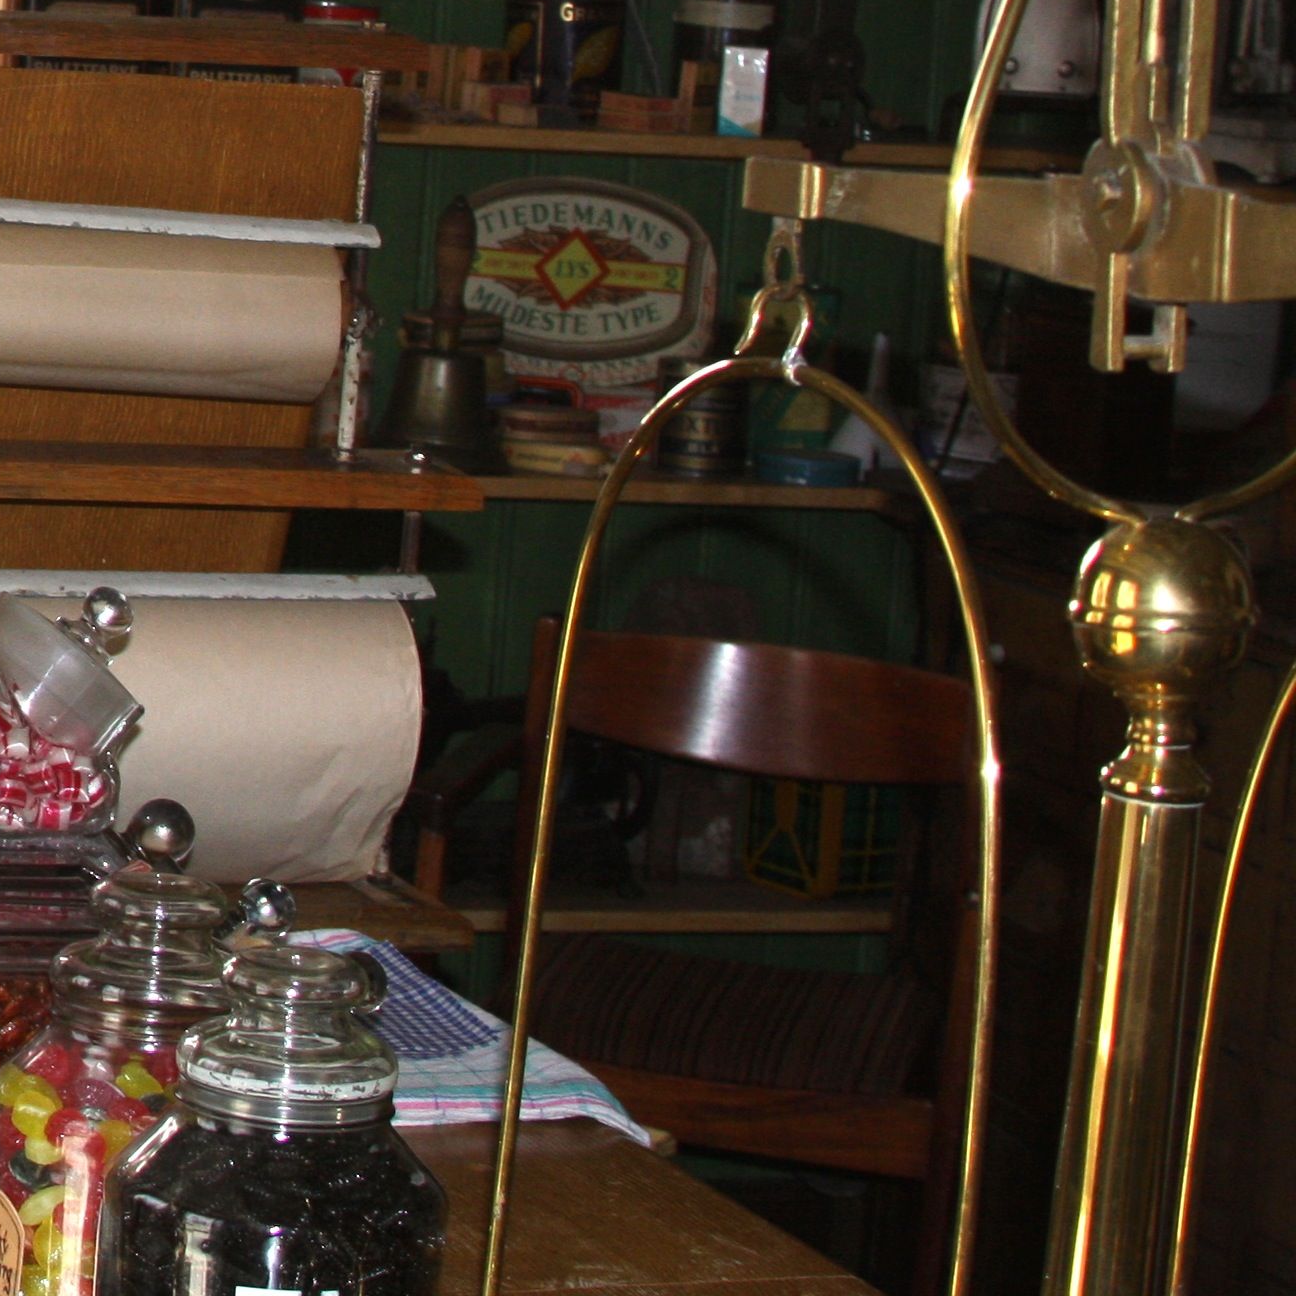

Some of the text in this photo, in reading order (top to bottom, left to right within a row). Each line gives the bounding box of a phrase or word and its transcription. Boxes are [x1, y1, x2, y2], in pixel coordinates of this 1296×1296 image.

[481, 201, 674, 252] TIEDEMANNS
[554, 260, 592, 279] LYS
[664, 267, 680, 290] 2
[472, 283, 660, 337] MILDESTE TYPE
